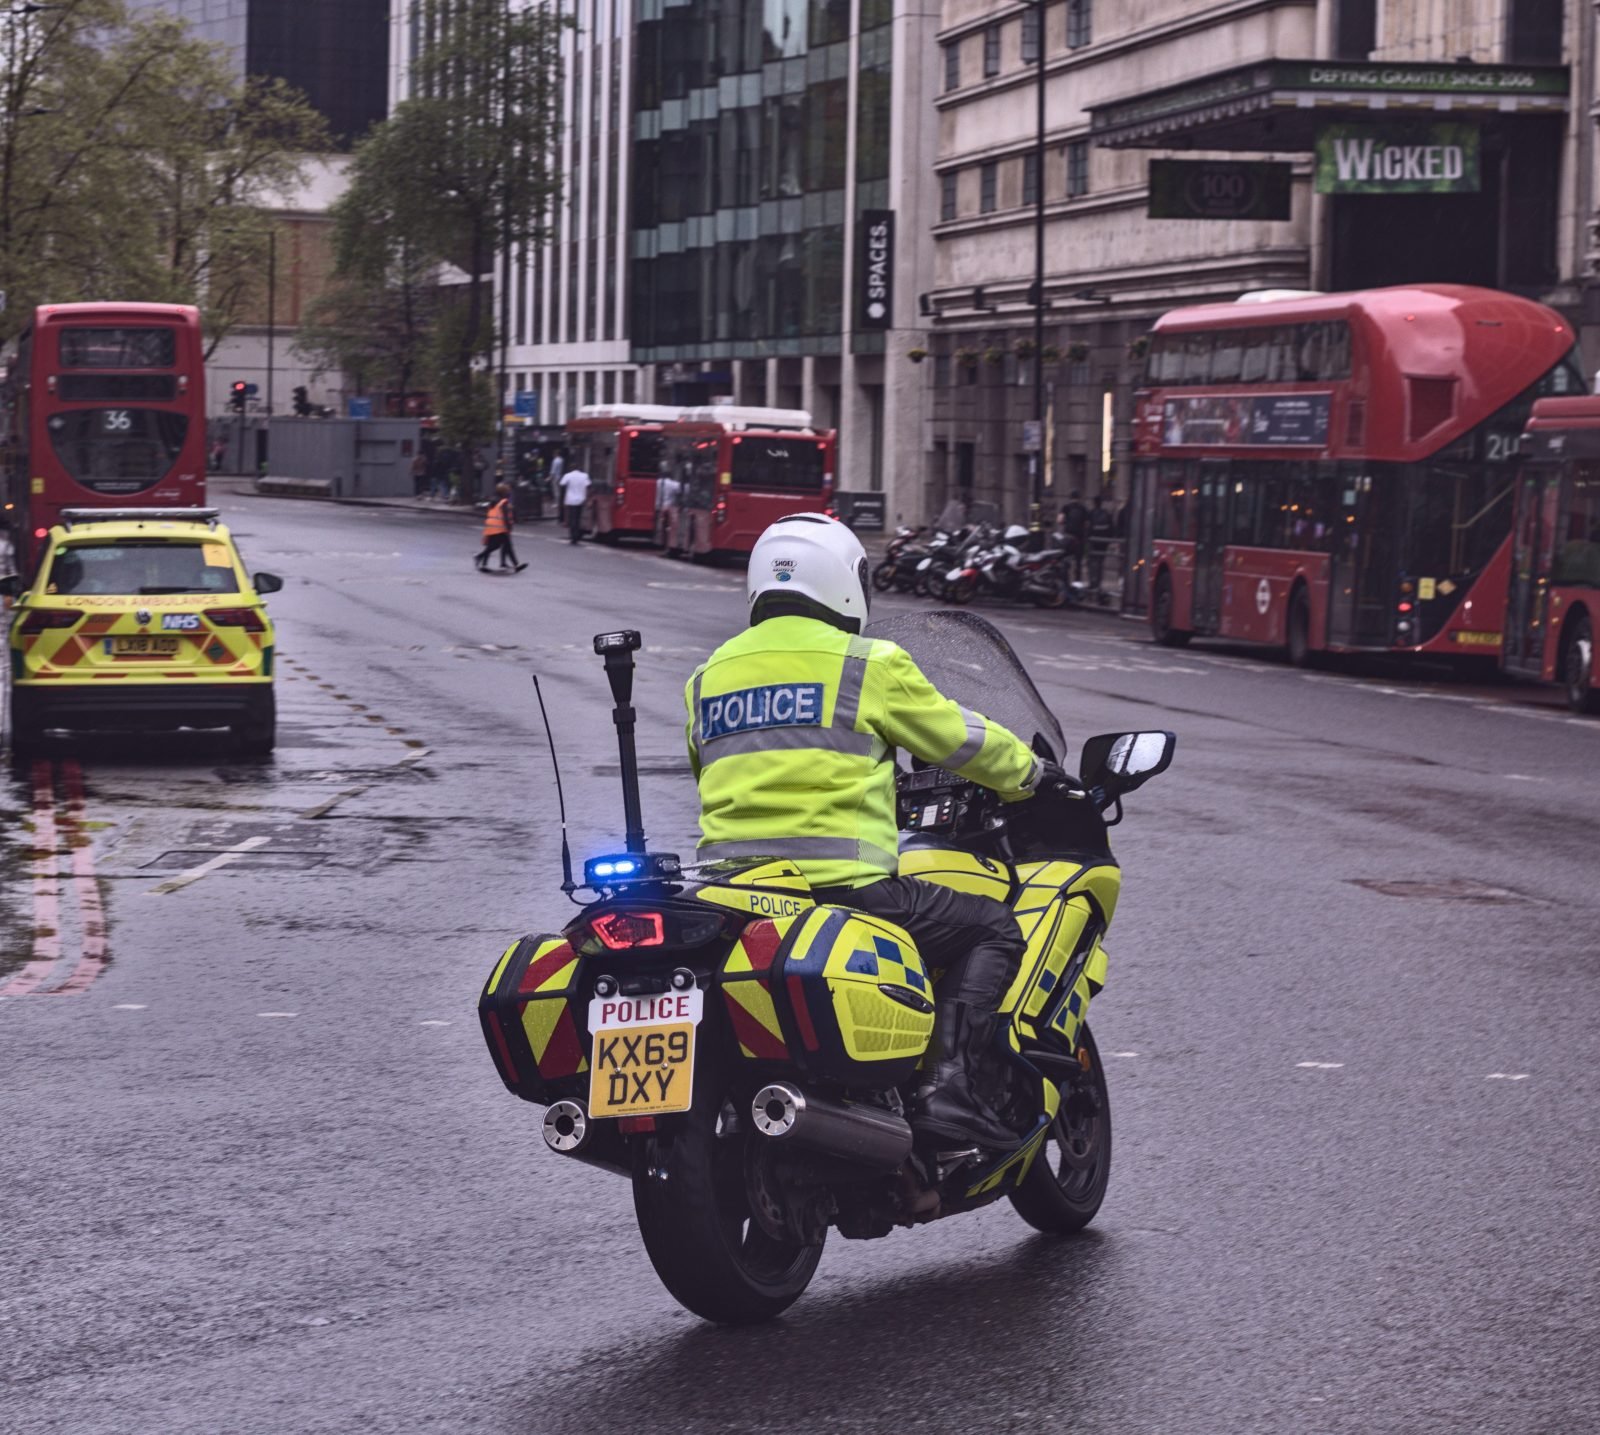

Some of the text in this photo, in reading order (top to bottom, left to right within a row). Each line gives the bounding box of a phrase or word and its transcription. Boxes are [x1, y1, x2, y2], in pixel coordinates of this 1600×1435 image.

[1309, 69, 1535, 87] DEFYING GRAVITY SINCE 2006
[1200, 174, 1245, 197] 100
[104, 410, 132, 429] 36
[65, 597, 127, 606] LONDON
[131, 596, 221, 606] AMBULANCE
[162, 614, 200, 629] NHS
[704, 687, 815, 737] POLICE
[750, 894, 801, 916] POLICE
[601, 995, 690, 1025] POLICE
[598, 1031, 688, 1070] KX69
[607, 1069, 675, 1106] DXY
